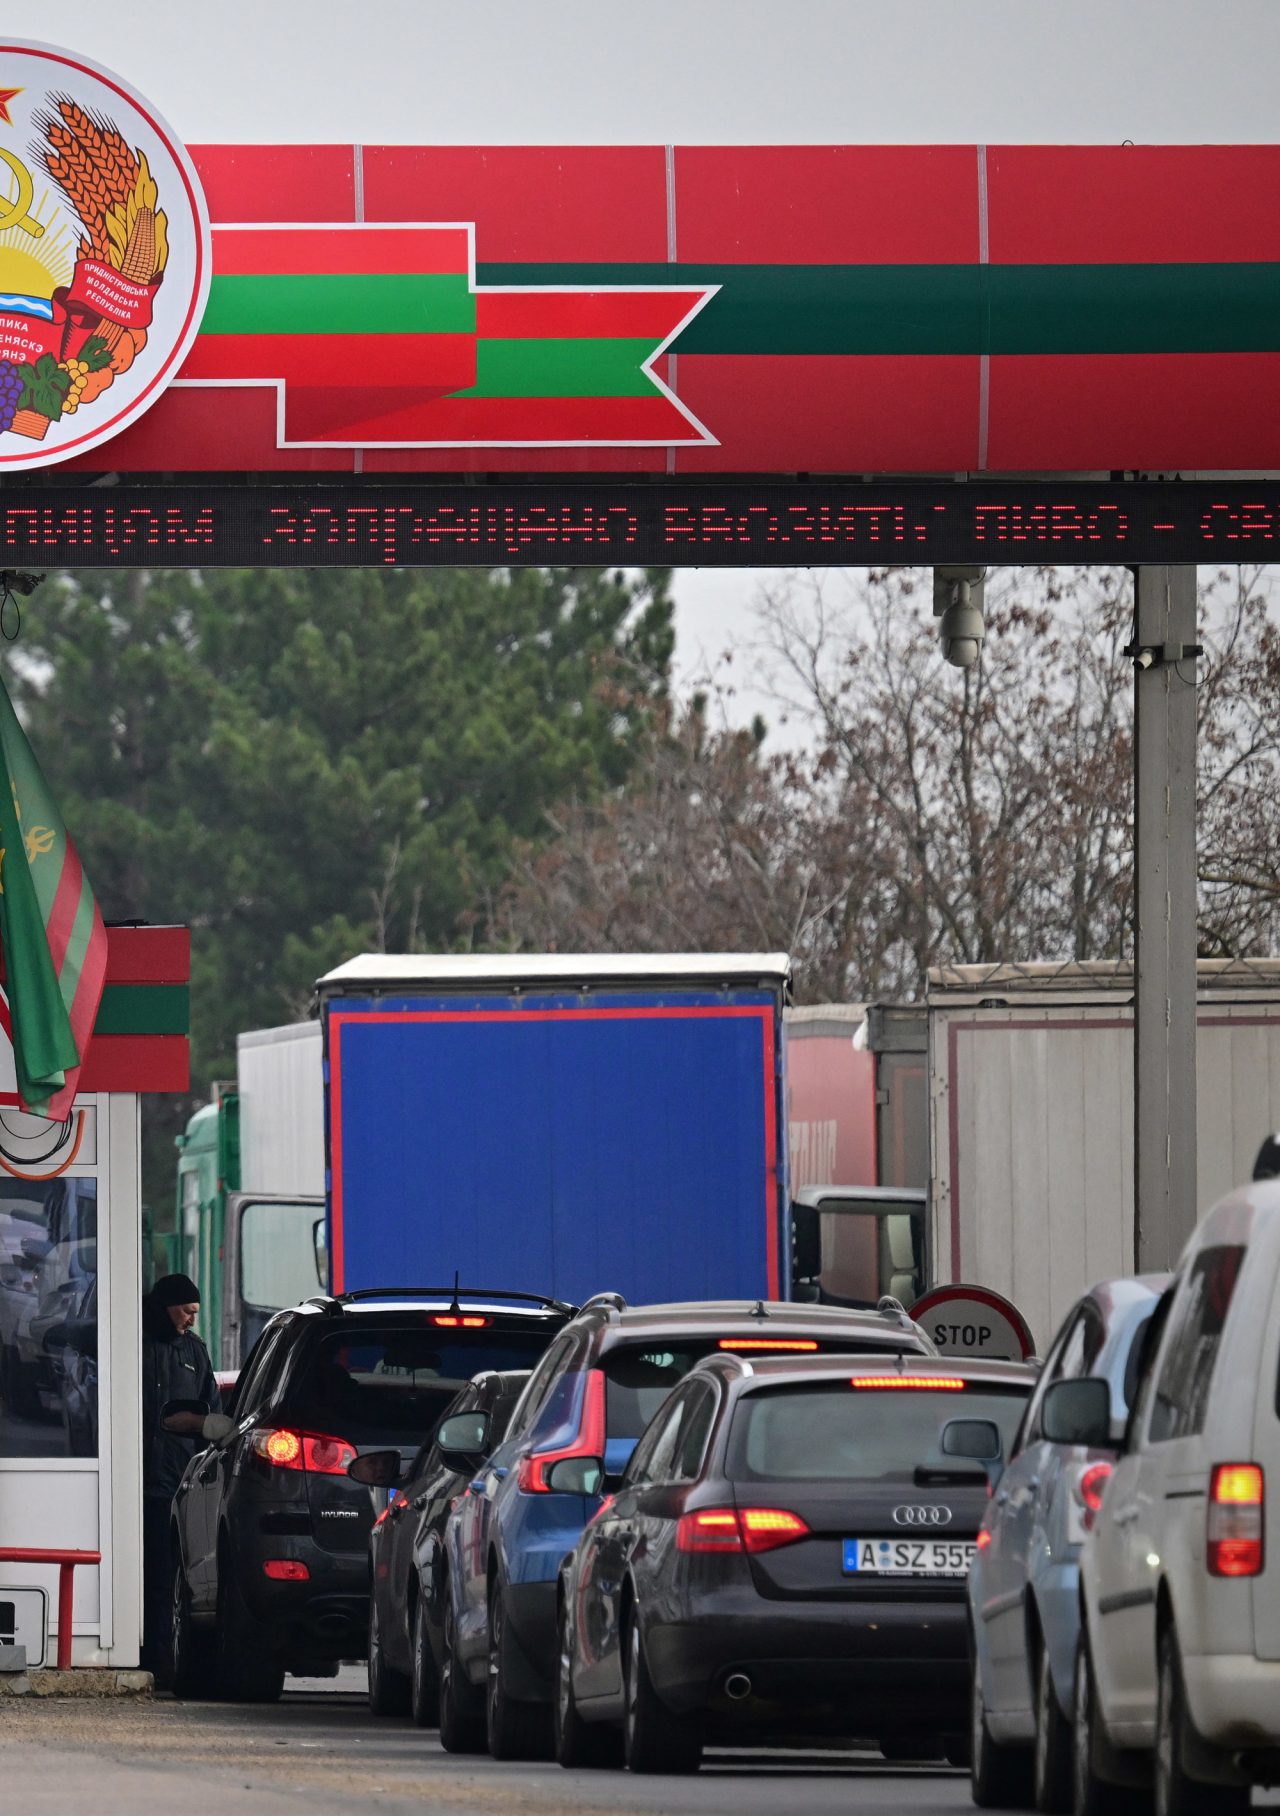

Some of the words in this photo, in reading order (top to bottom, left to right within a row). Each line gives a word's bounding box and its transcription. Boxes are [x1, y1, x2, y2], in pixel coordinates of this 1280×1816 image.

[84, 263, 149, 297] ПРИДНІСТРОВСЬКА
[86, 276, 139, 309] МОЛДАВСЬКА
[85, 289, 131, 320] РЕСПУБЛІКА
[934, 1324, 991, 1346] STOP
[321, 1511, 359, 1519] HYUNDAI
[861, 1543, 875, 1567] A
[894, 1543, 926, 1568] SZ
